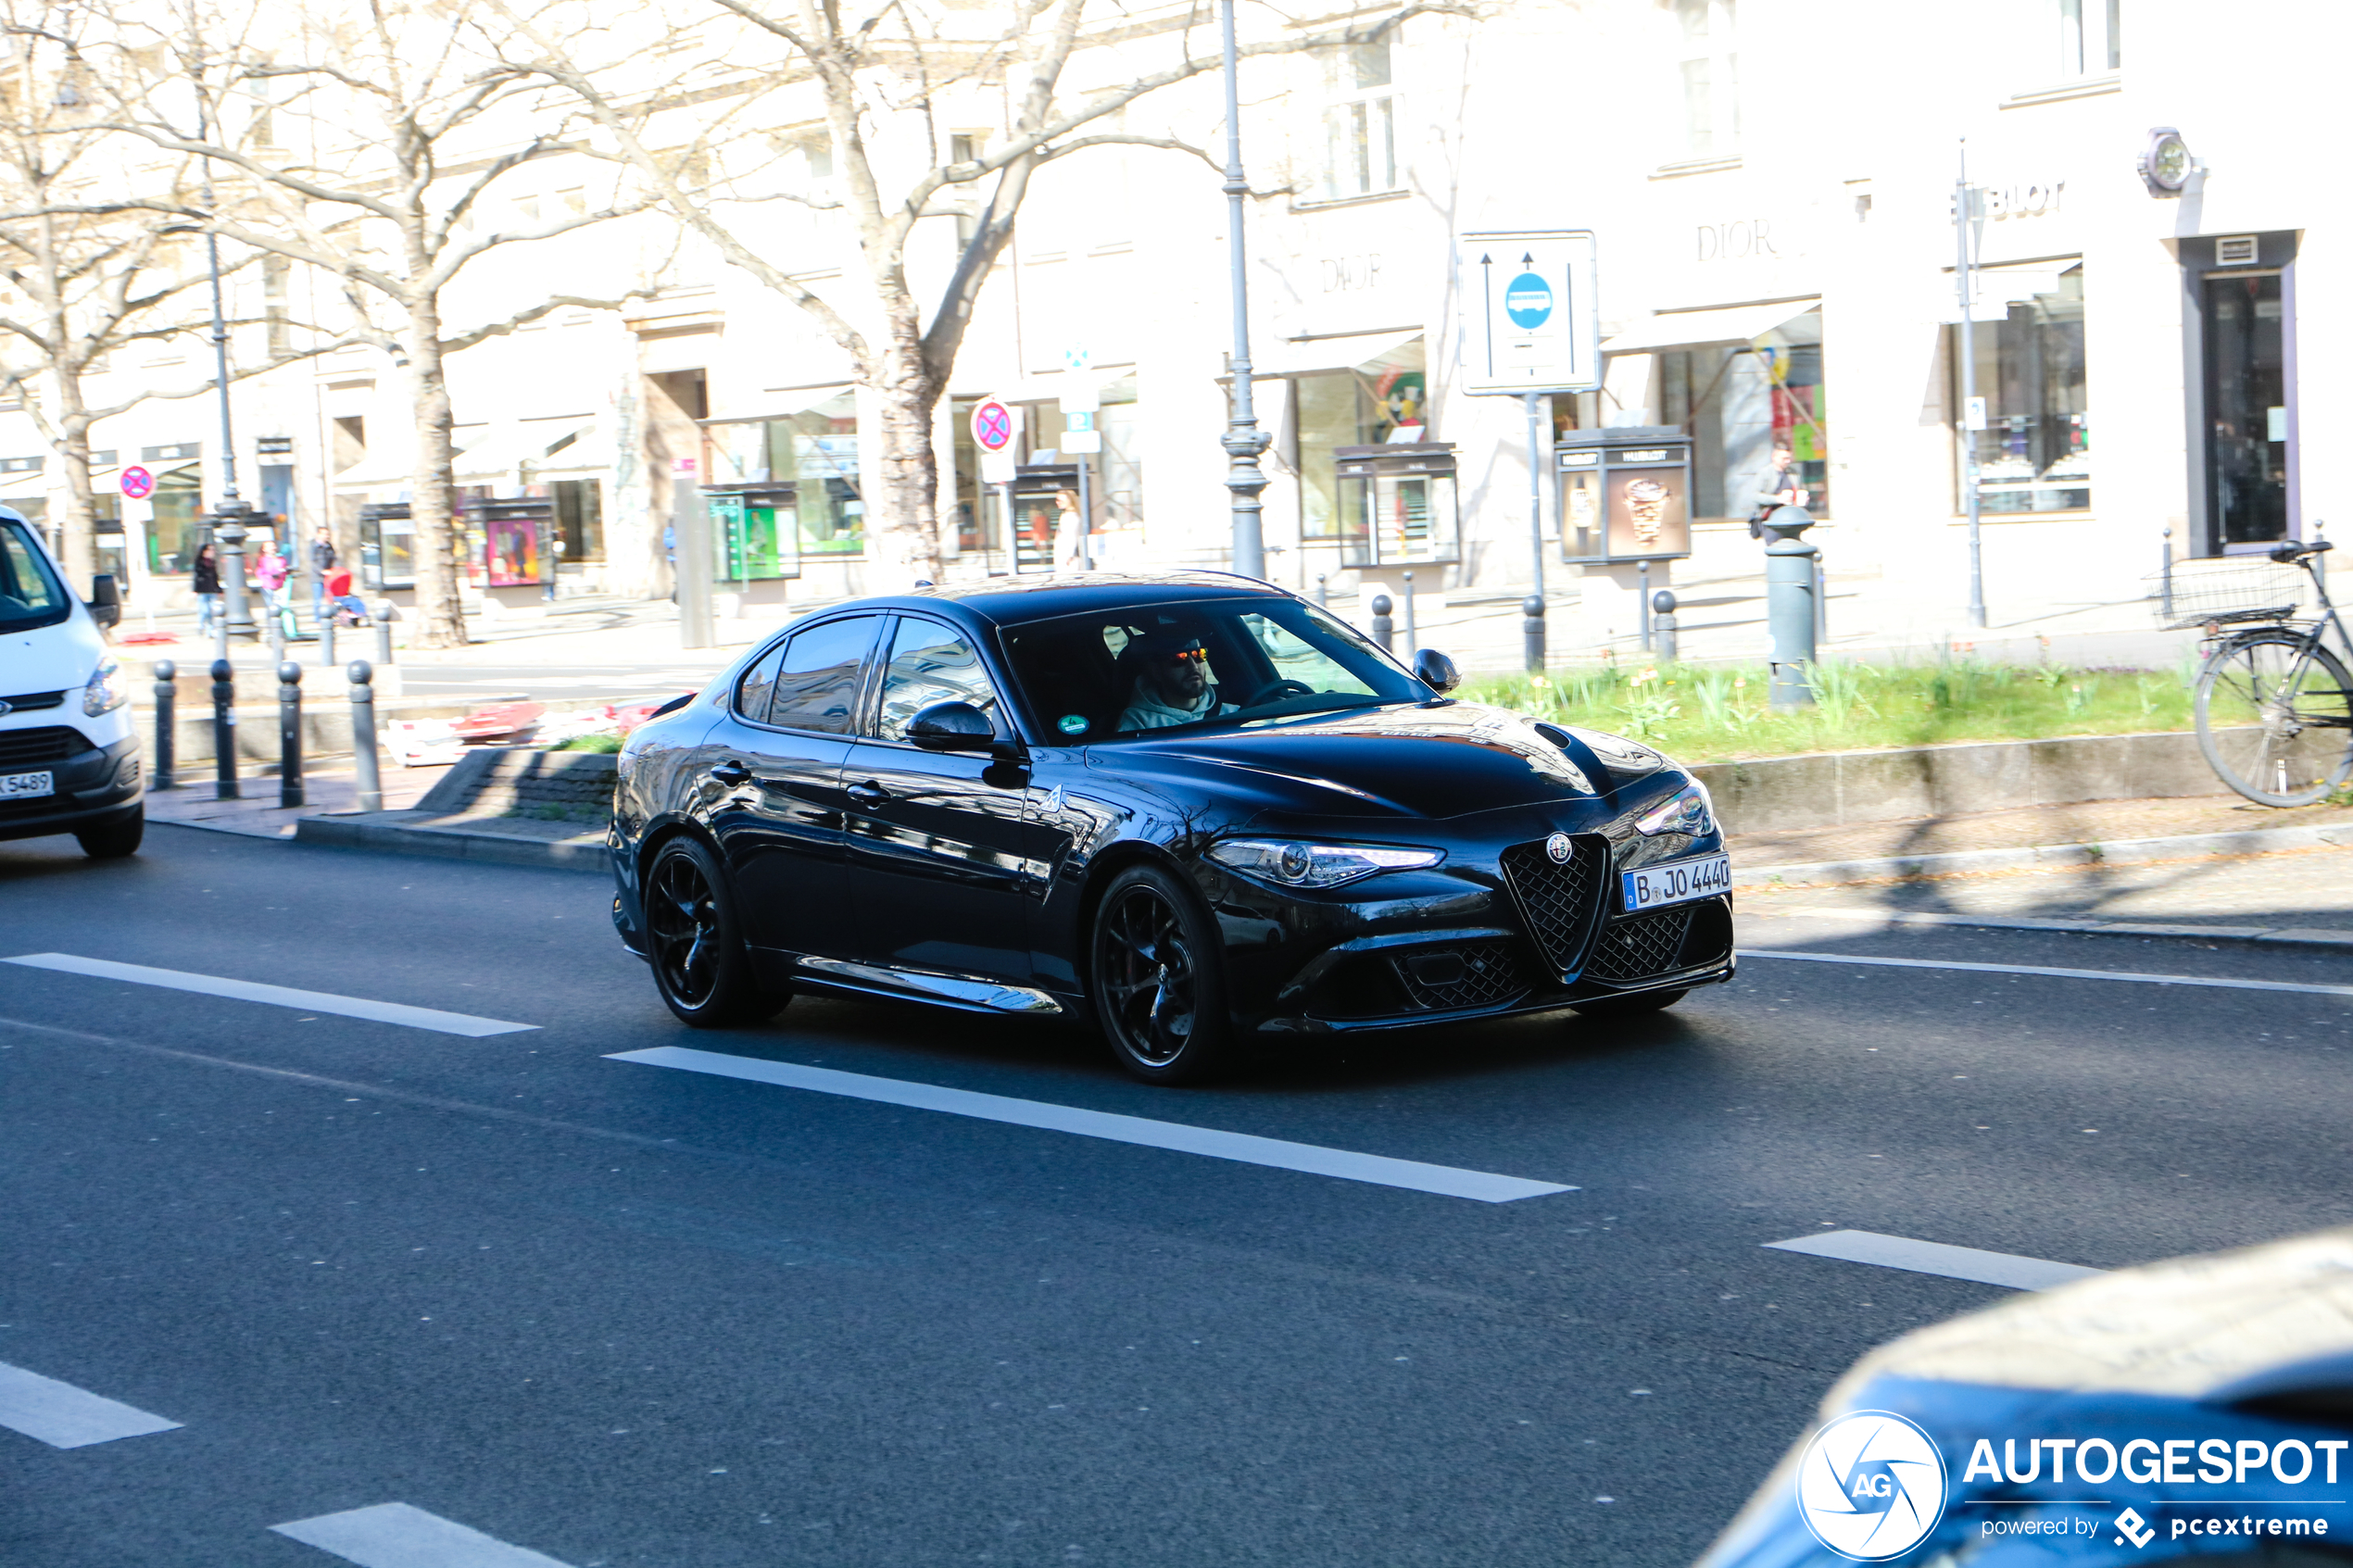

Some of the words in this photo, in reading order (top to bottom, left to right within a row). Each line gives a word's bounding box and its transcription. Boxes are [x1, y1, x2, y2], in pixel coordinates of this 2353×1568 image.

[1697, 219, 1777, 262] DIOR
[1320, 253, 1384, 294] DIOR
[8, 773, 48, 793] 5489
[1636, 875, 1651, 904] B
[1664, 868, 1688, 898] JO
[1692, 859, 1730, 893] 4440
